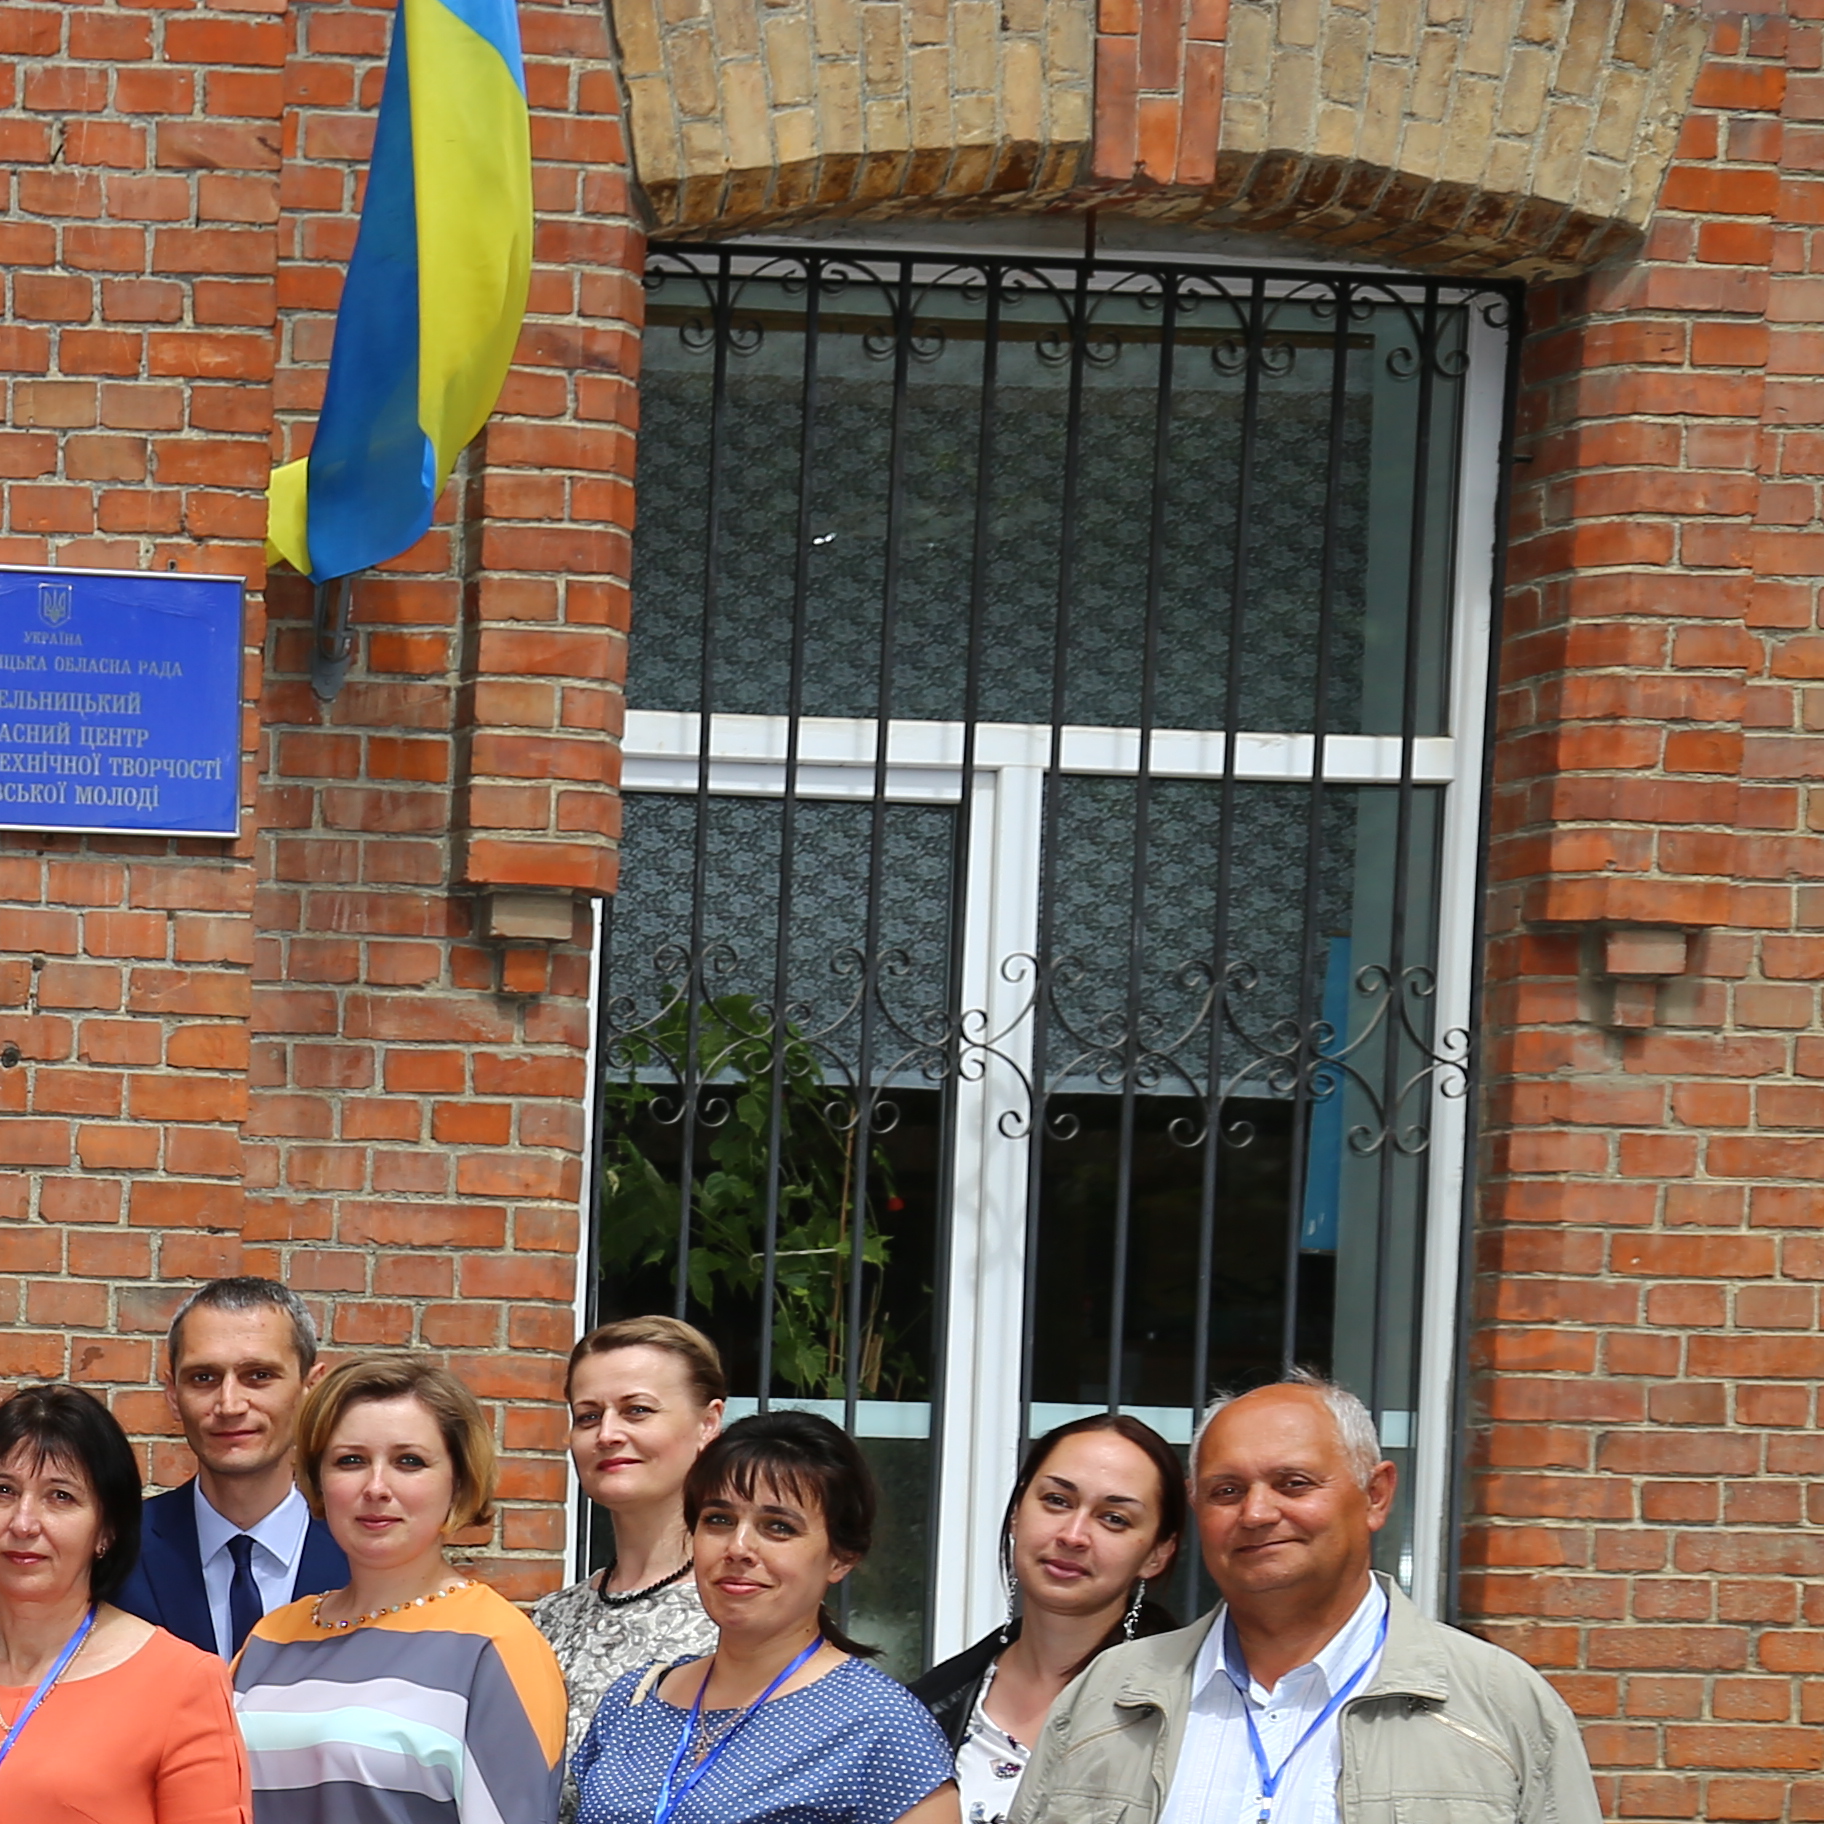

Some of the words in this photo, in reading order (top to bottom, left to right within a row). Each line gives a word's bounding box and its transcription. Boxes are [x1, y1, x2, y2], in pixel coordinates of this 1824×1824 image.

[23, 630, 84, 646] УКРАЇНА
[54, 657, 132, 675] ОБЛАСНА
[138, 660, 183, 678] РАДА
[80, 726, 150, 750] ЦЕНТР
[109, 755, 223, 780] ТВОРЧОСТІ
[75, 784, 161, 811] МОЛОДІ
